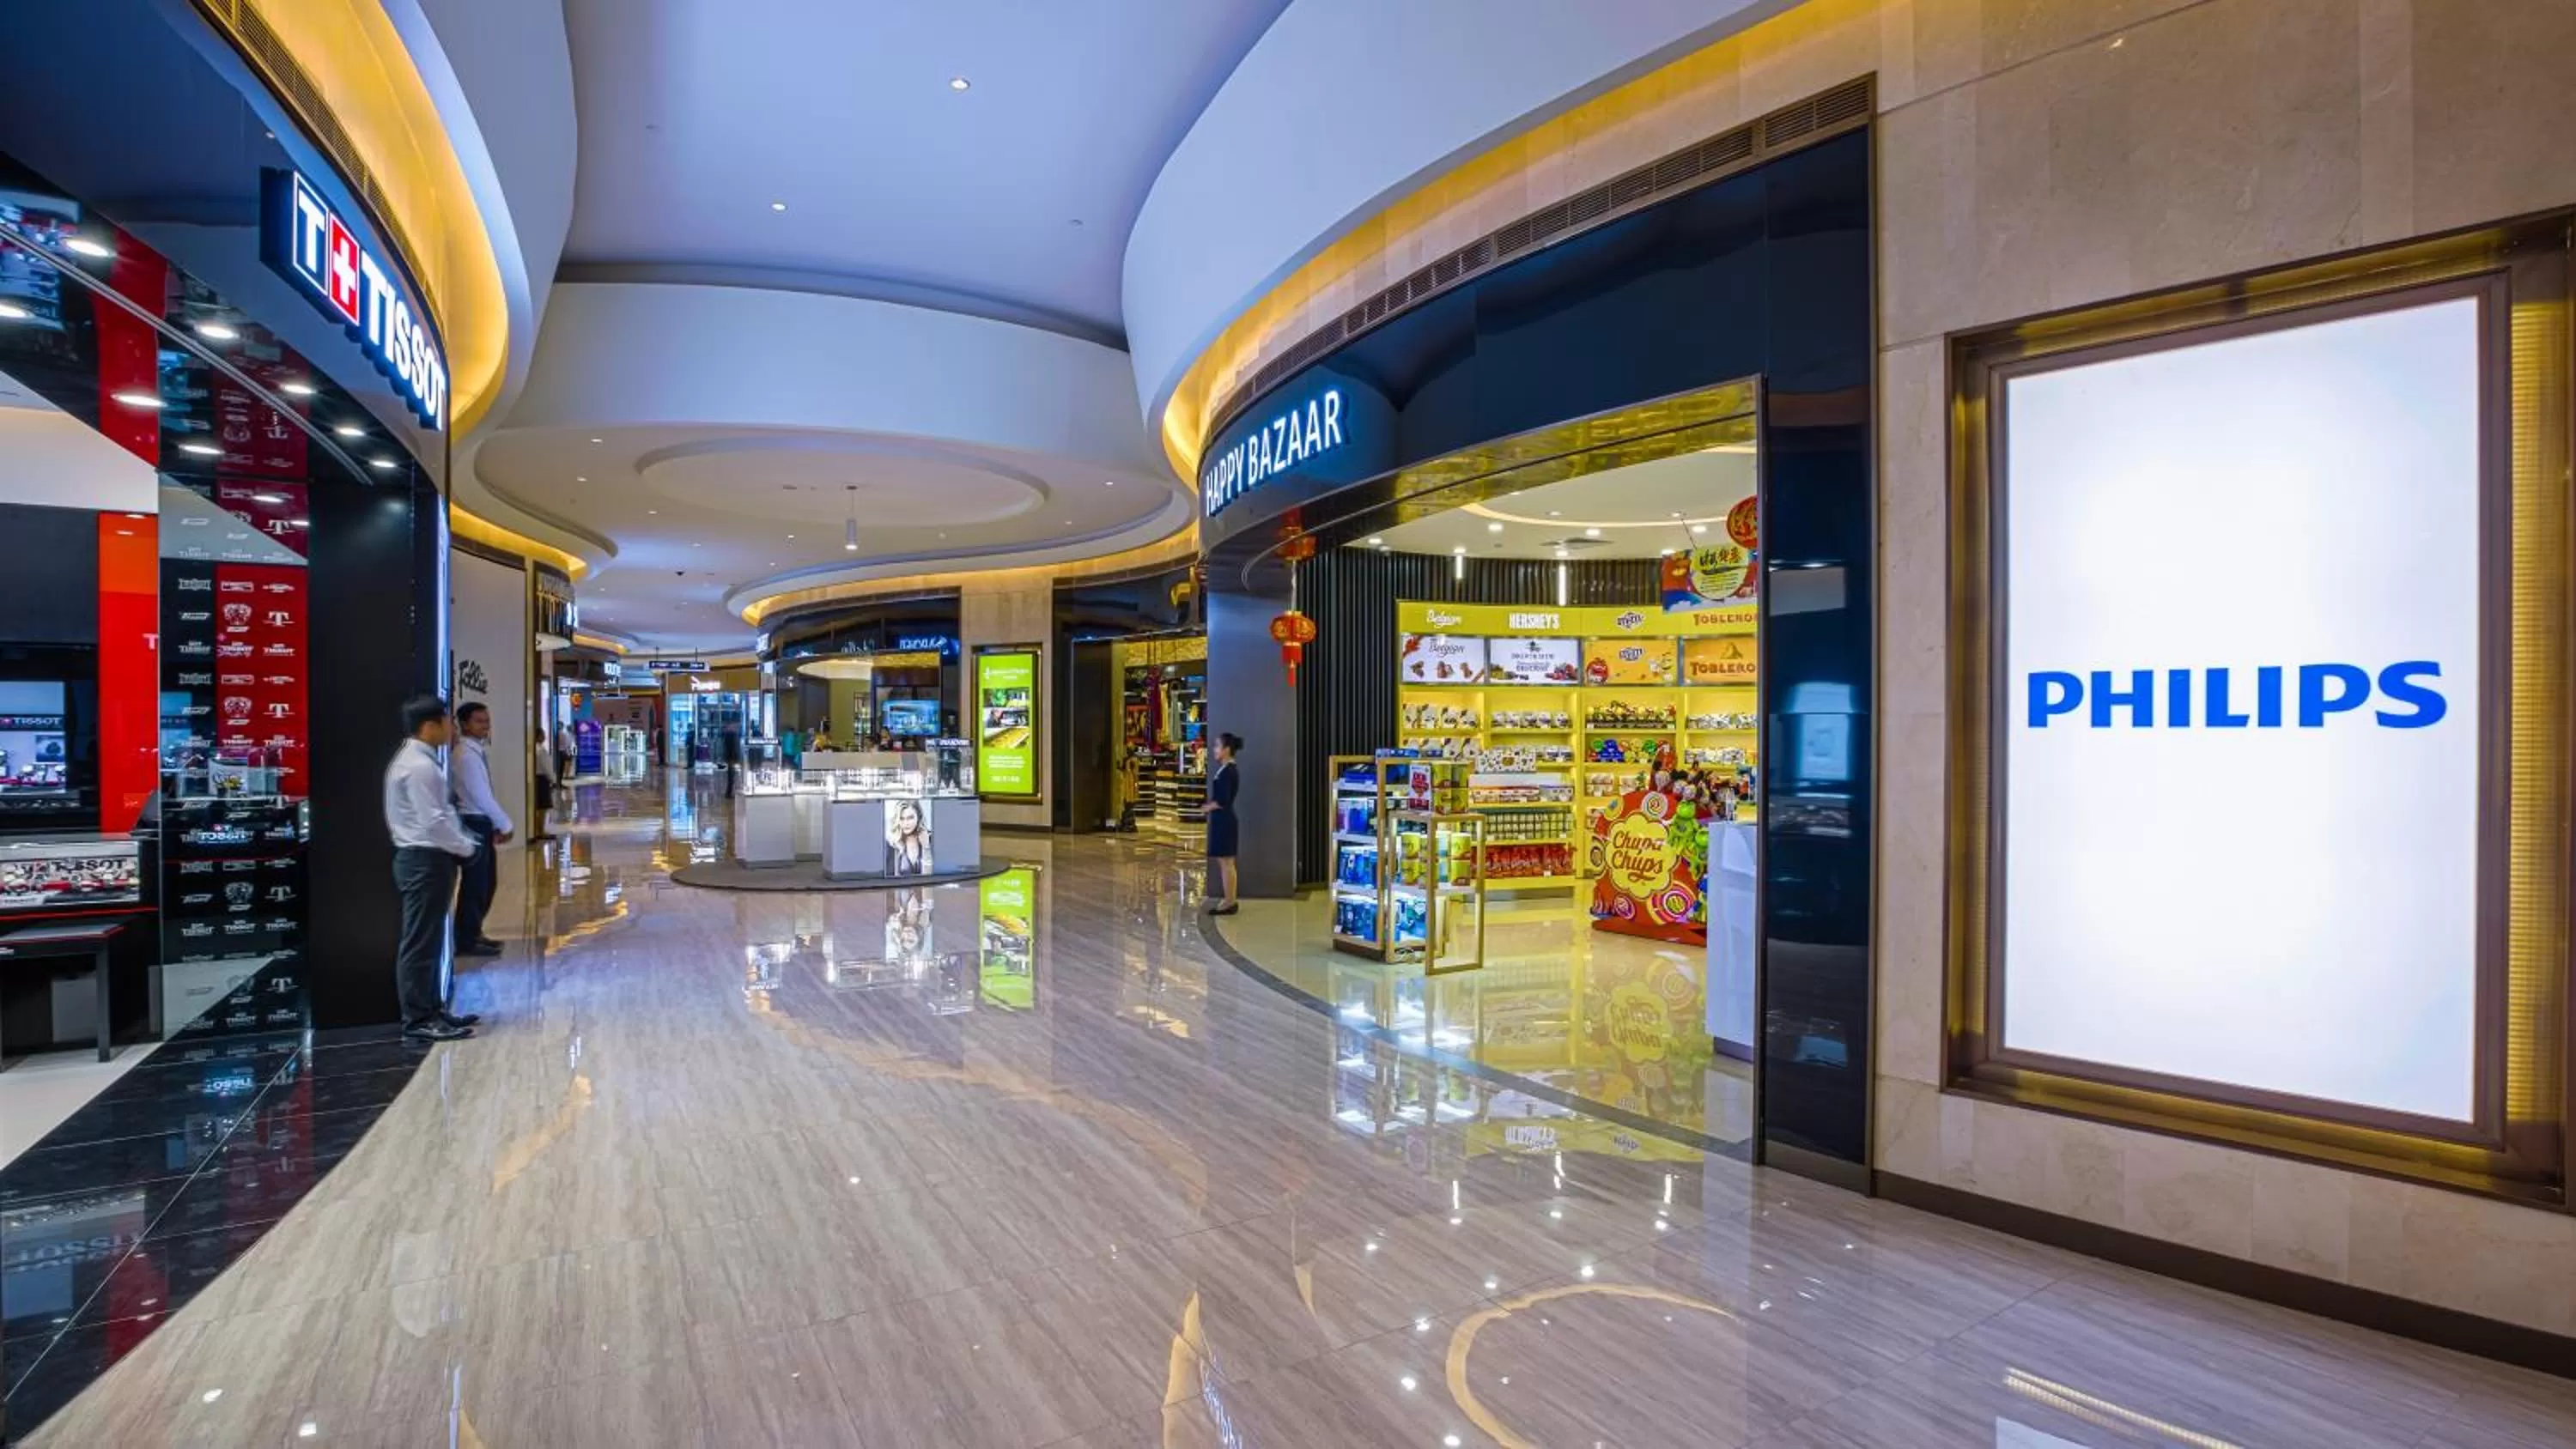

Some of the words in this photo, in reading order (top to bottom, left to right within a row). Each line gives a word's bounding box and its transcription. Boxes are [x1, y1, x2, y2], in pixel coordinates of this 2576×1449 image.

[361, 250, 446, 431] TISSOT
[1206, 444, 1244, 517] HAPPY
[1249, 391, 1341, 485] BAZAAR
[1509, 612, 1560, 630] HERSHEY'S
[1693, 613, 1758, 626] TOBLERO
[459, 659, 488, 700] Follie
[2028, 661, 2447, 728] PHILIPS
[13, 717, 62, 726] TISSOT
[1613, 830, 1665, 853] Chupa
[1612, 849, 1663, 876] Chups
